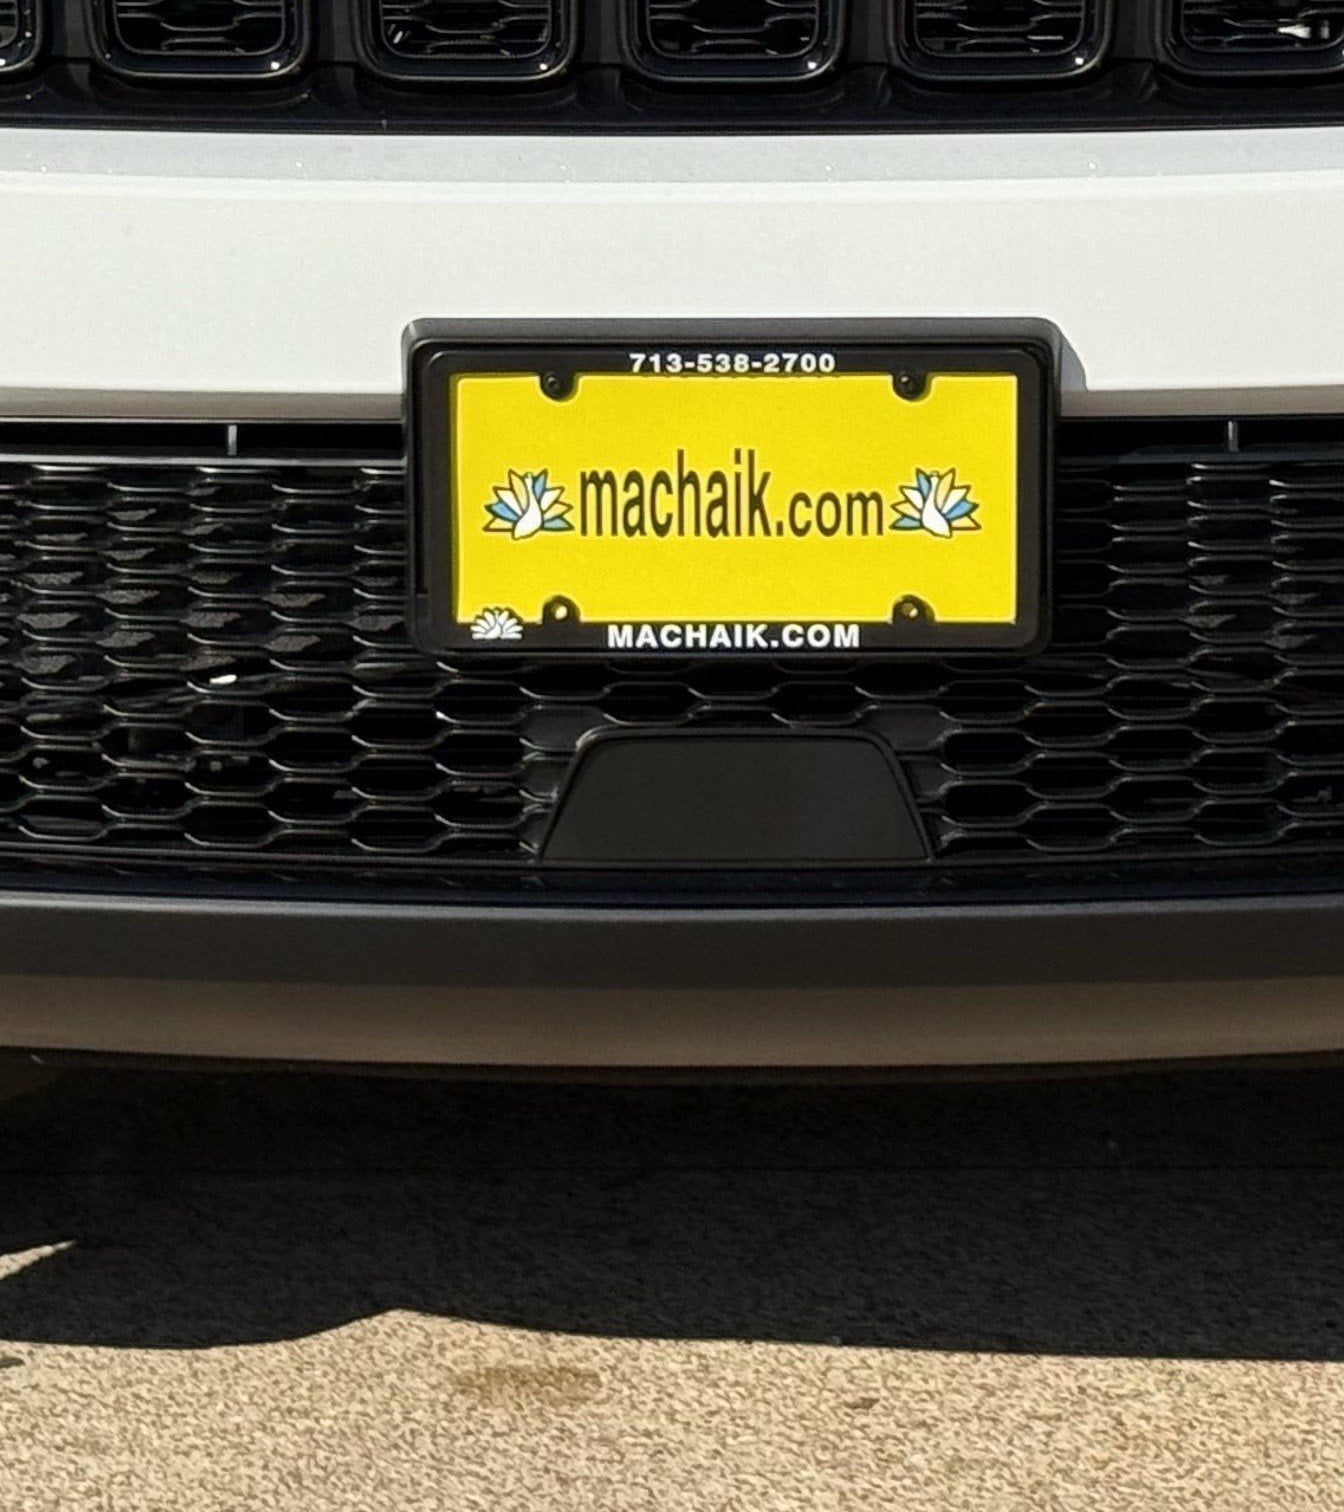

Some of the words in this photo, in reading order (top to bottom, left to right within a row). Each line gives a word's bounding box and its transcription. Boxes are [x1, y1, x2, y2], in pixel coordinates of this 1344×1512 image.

[629, 353, 836, 373] 713-538-2700
[578, 448, 884, 537] machaik.com
[607, 624, 860, 648] MACHAIK.COM
